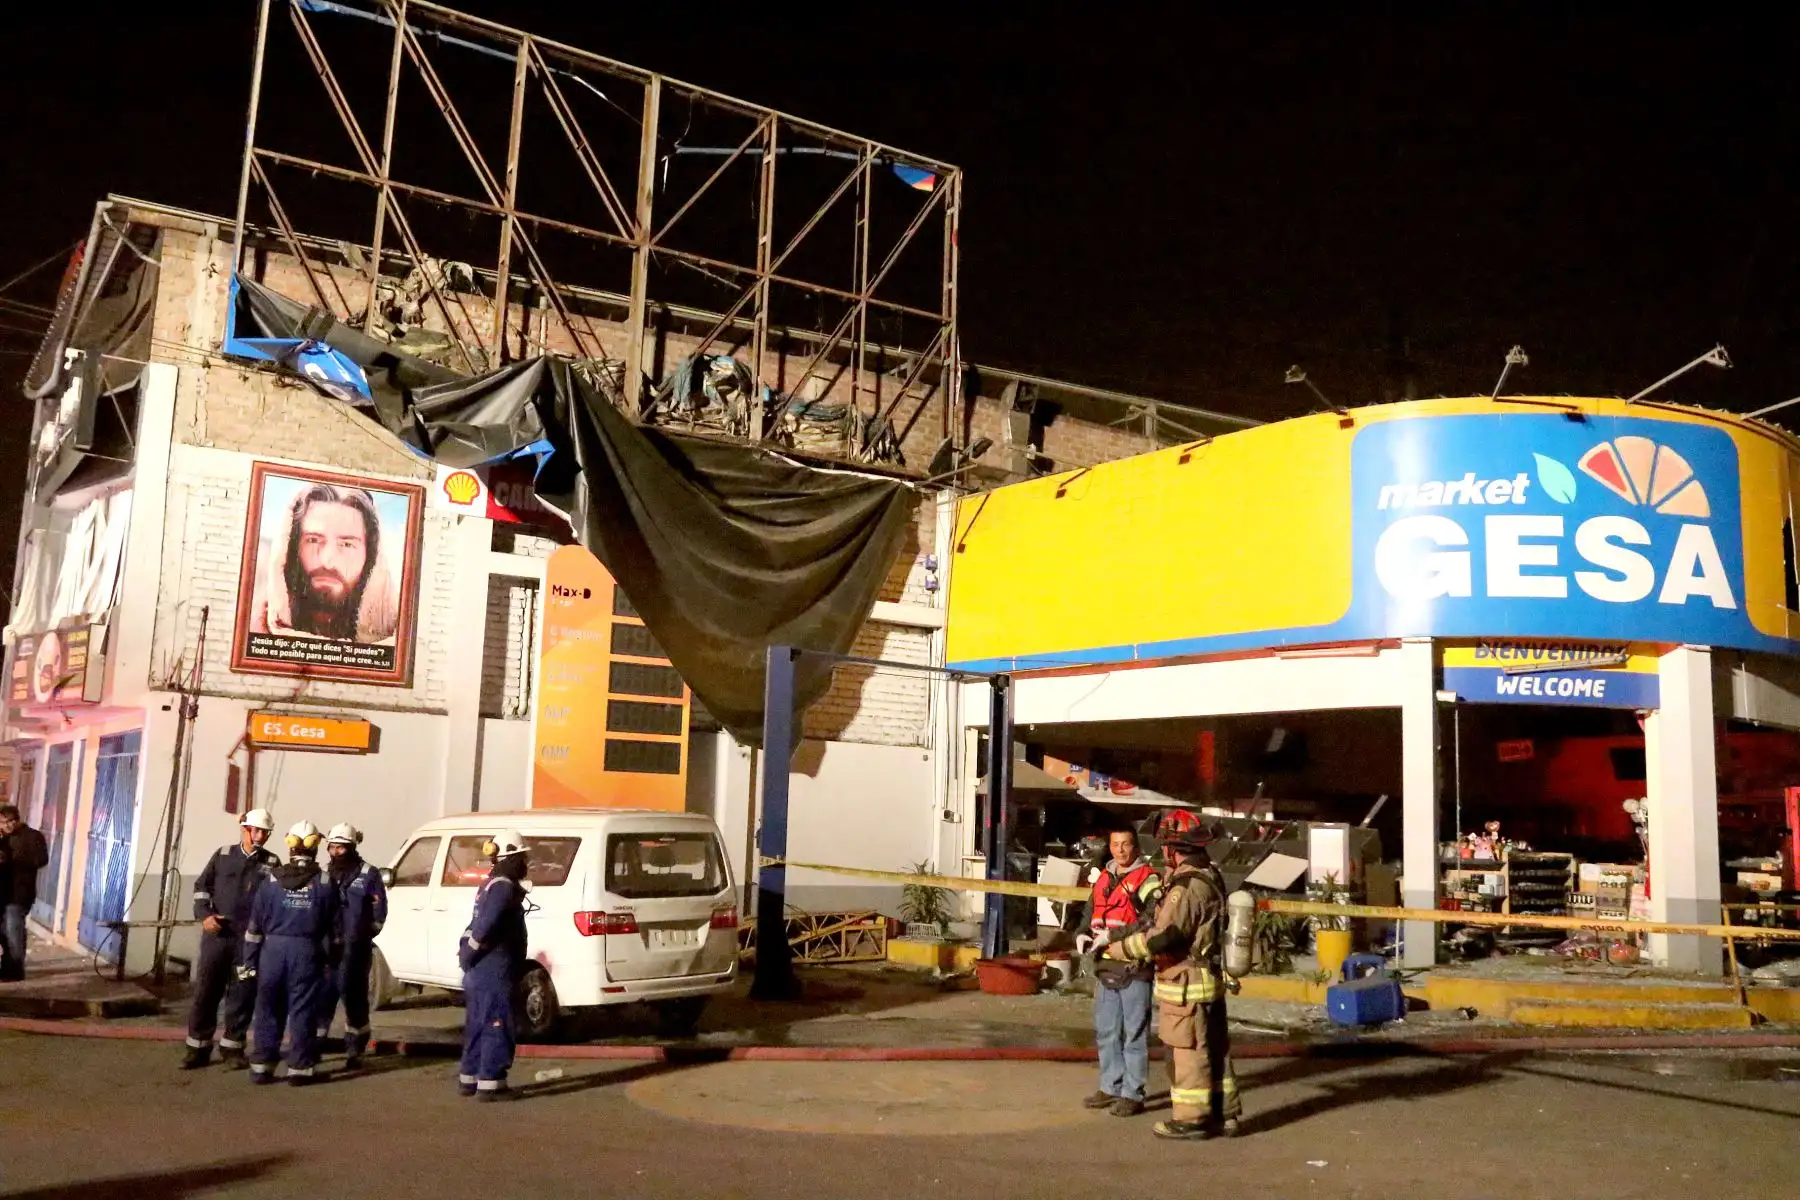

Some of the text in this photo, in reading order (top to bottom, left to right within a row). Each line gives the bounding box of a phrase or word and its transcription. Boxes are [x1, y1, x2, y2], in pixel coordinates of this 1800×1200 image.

[1377, 472, 1530, 511] market
[1374, 514, 1738, 610] GESA
[251, 636, 273, 646] Jesús
[274, 638, 290, 648] dijo:
[291, 640, 308, 649] ¿Por
[308, 642, 322, 652] qué
[323, 643, 341, 652] dices
[251, 646, 269, 655] Todo
[279, 650, 306, 658] posible
[322, 653, 342, 662] aquel
[343, 656, 356, 664] que
[1496, 675, 1606, 698] WELCOME
[290, 724, 326, 738] Gesa
